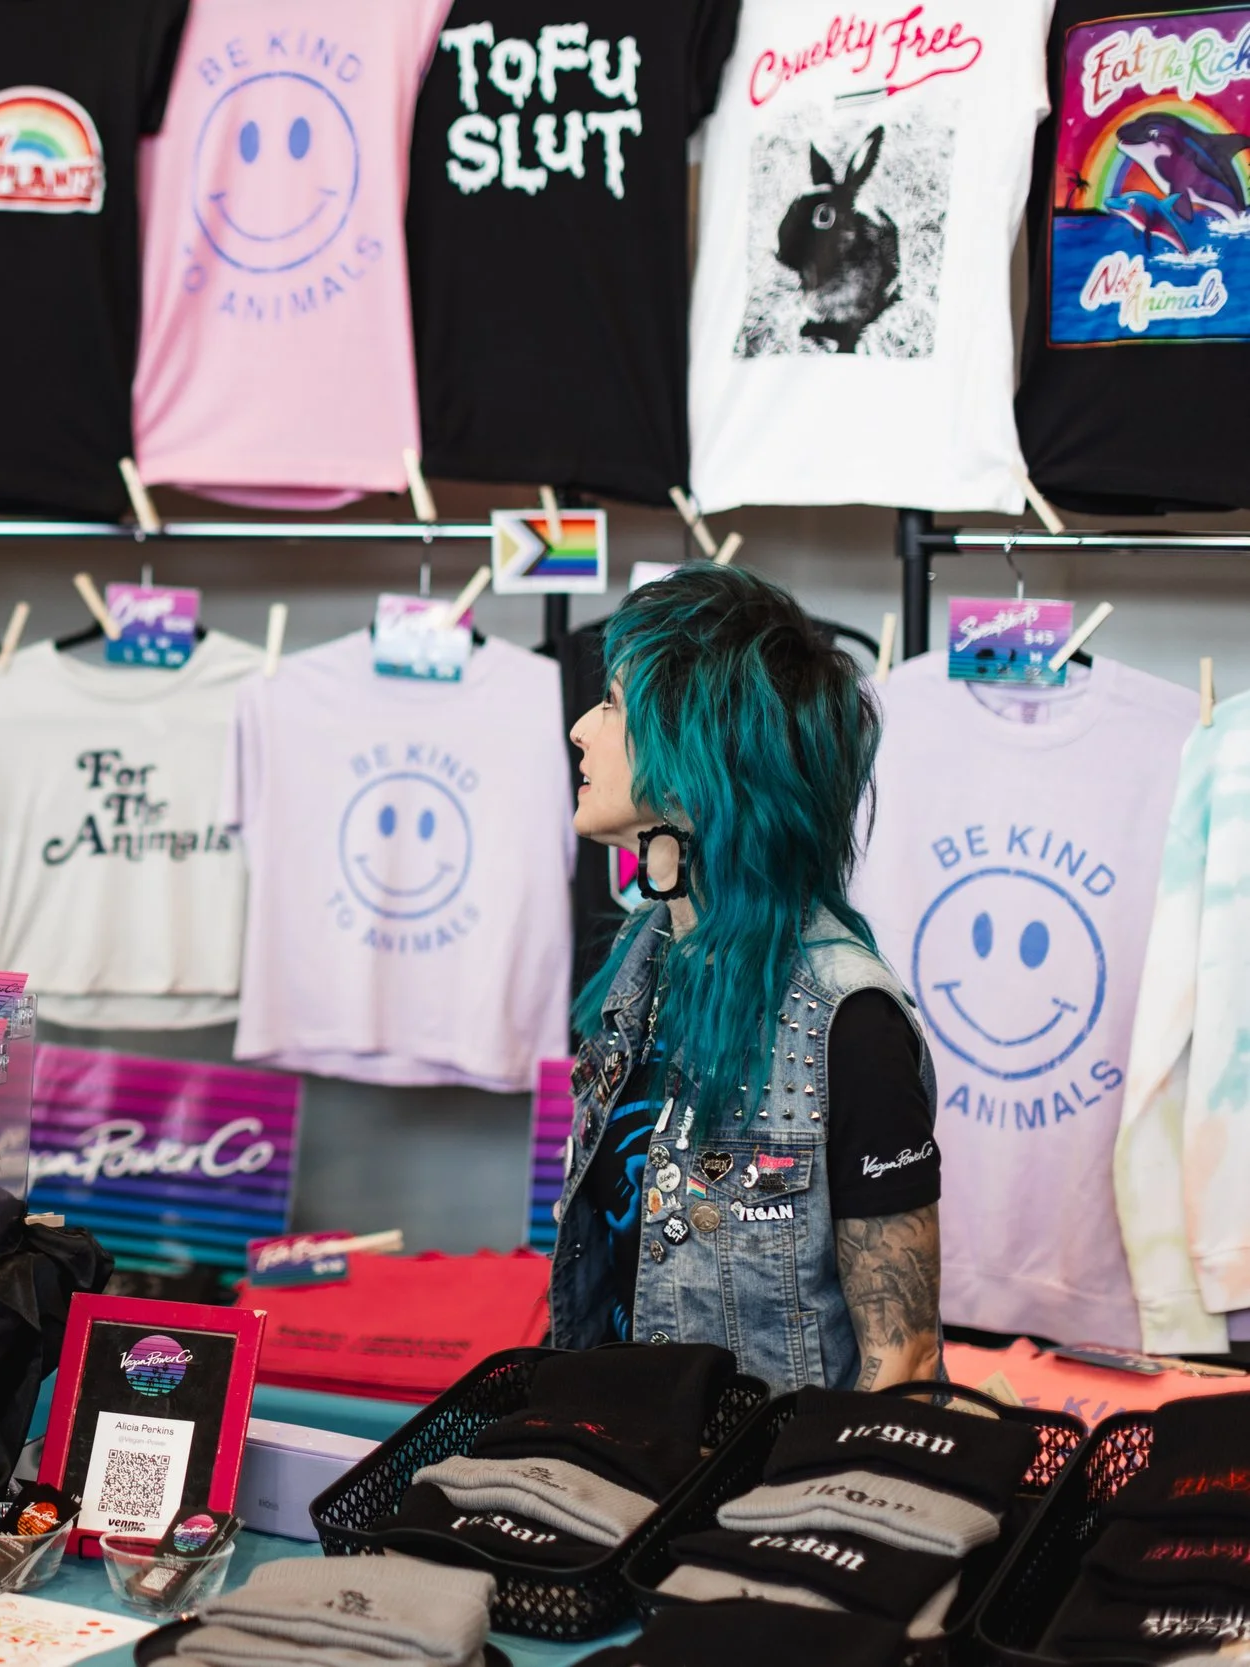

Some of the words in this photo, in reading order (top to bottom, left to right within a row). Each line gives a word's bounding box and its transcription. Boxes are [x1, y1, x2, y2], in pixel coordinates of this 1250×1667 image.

[196, 38, 249, 89] BE
[266, 27, 364, 87] KIND
[441, 21, 641, 111] TOFU
[749, 15, 880, 107] Cruelty
[882, 4, 976, 84] Free
[1093, 36, 1145, 104] Eat
[1149, 43, 1186, 83] The
[1188, 32, 1250, 94] Rich
[447, 109, 641, 199] SLUT
[217, 233, 386, 323] ANIMALS
[76, 749, 157, 789] For
[350, 743, 393, 779] BE
[405, 742, 481, 797] KIND
[103, 792, 168, 826] The
[42, 815, 232, 868] Animals
[931, 825, 989, 873] BE
[1007, 825, 1117, 898] KIND
[362, 902, 481, 955] ANIMALS
[945, 1058, 1125, 1132] ANIMALS
[729, 1203, 794, 1222] VEGAN
[115, 1421, 139, 1432] Alicia
[141, 1424, 174, 1436] Perkins
